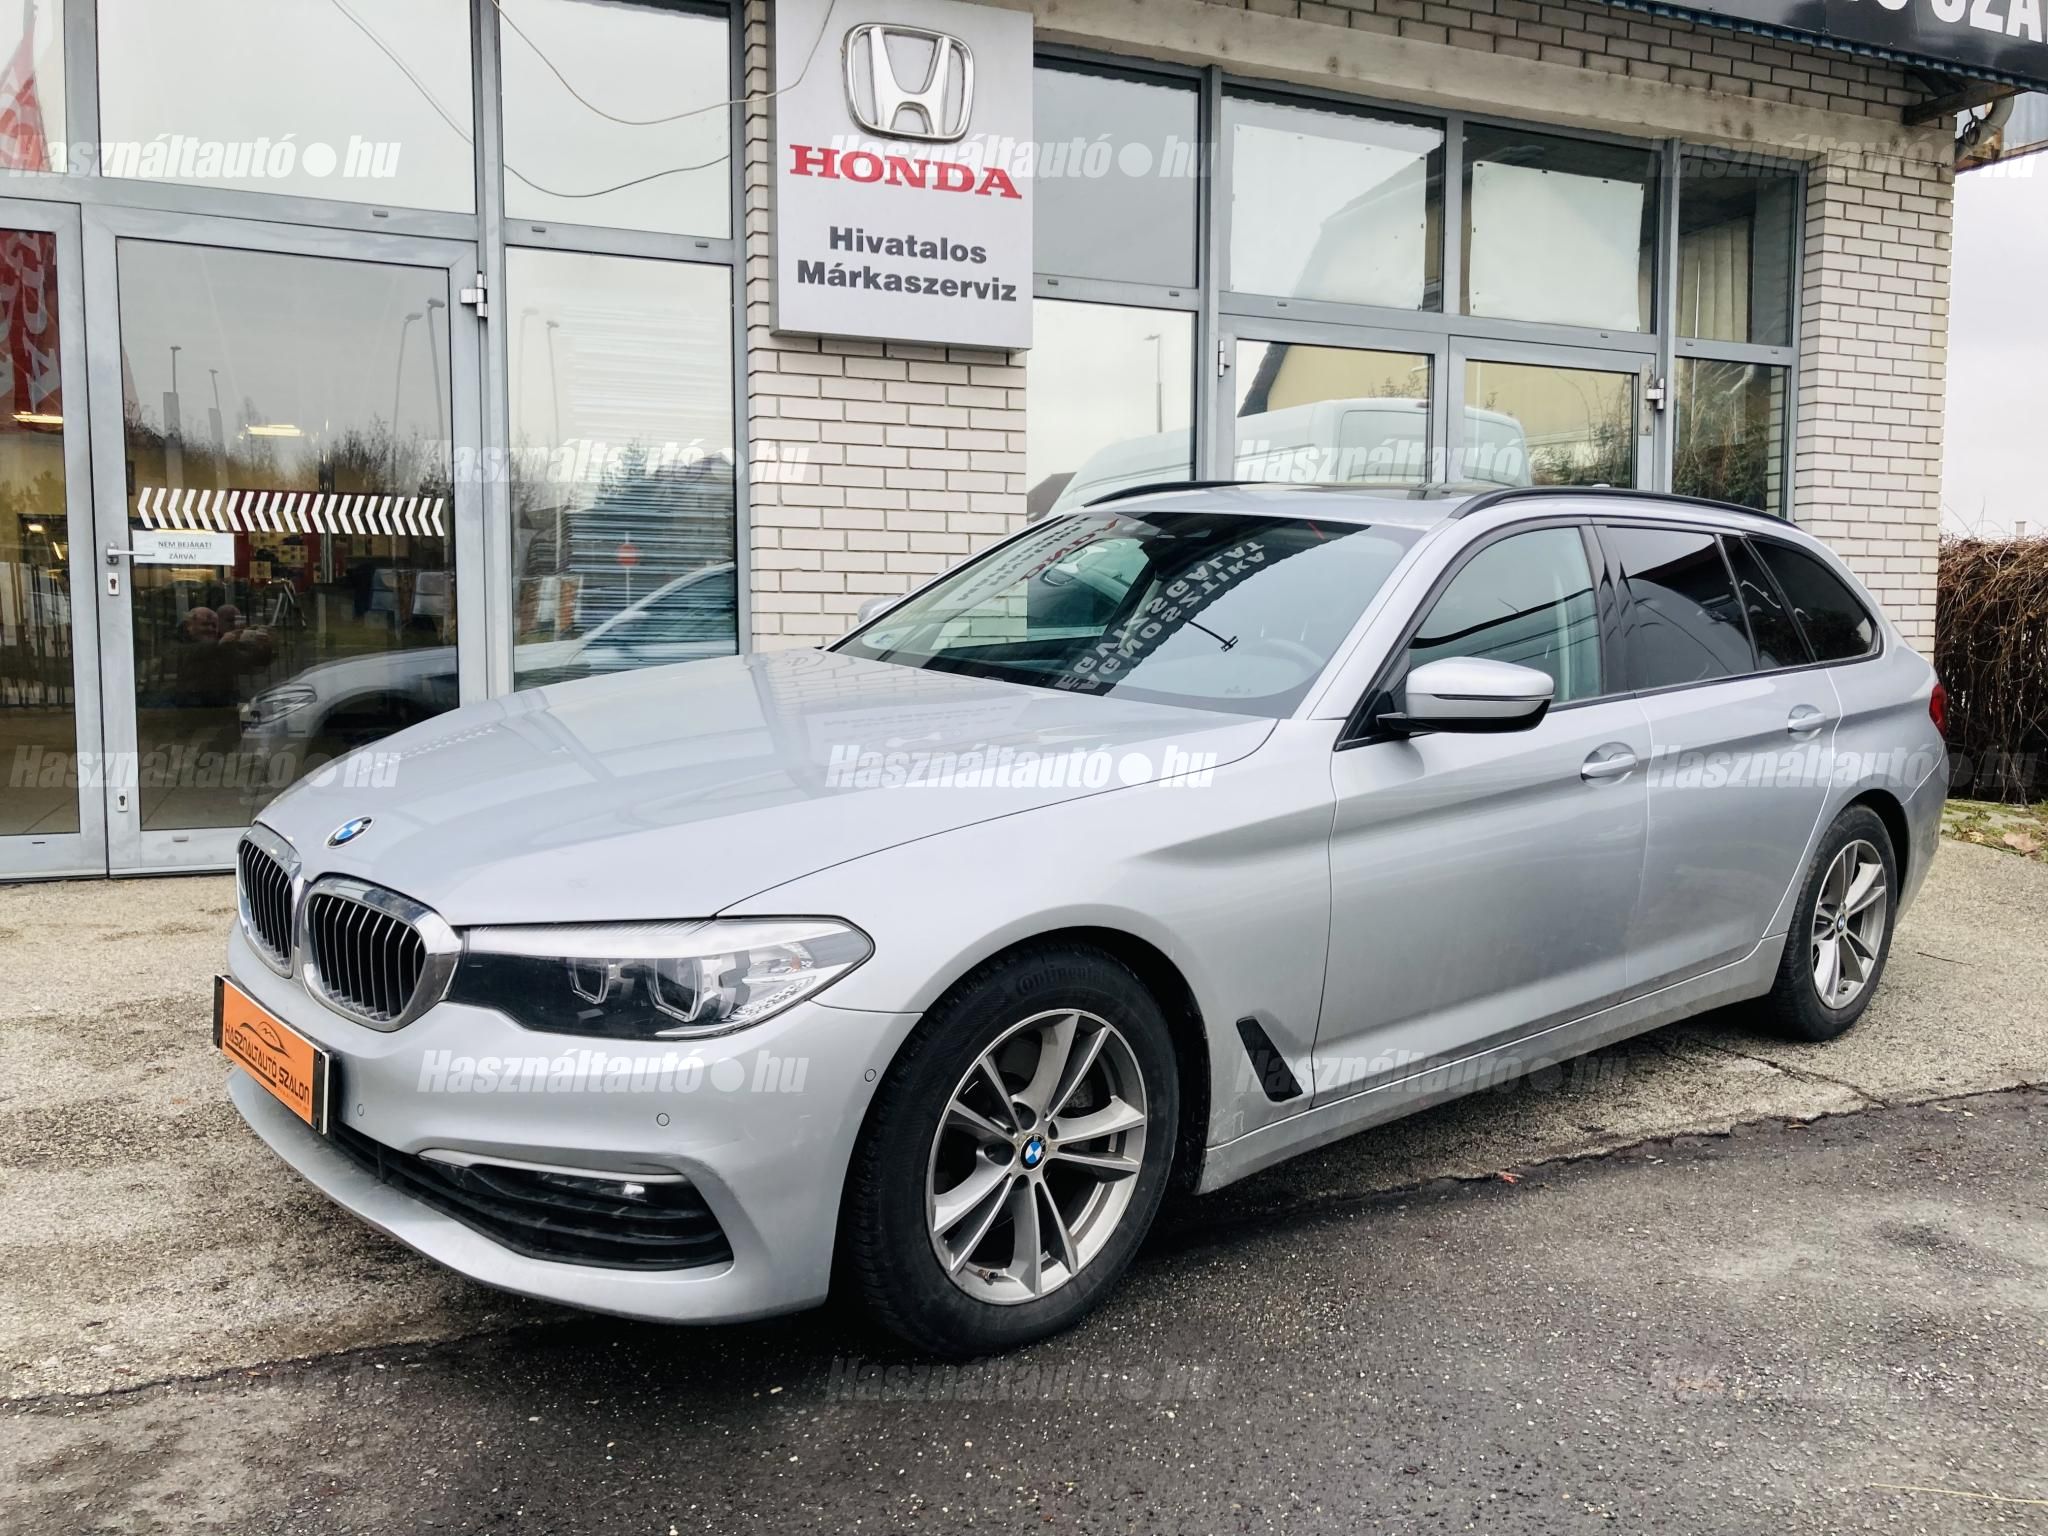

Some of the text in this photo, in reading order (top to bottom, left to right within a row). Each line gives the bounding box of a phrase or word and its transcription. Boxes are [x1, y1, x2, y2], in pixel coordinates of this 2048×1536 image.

[789, 144, 1023, 199] HONDA
[829, 225, 987, 264] Hivatalos
[797, 259, 1017, 302] Márkaszerviz
[158, 541, 176, 549] NEM
[278, 1066, 310, 1105] SZALON
